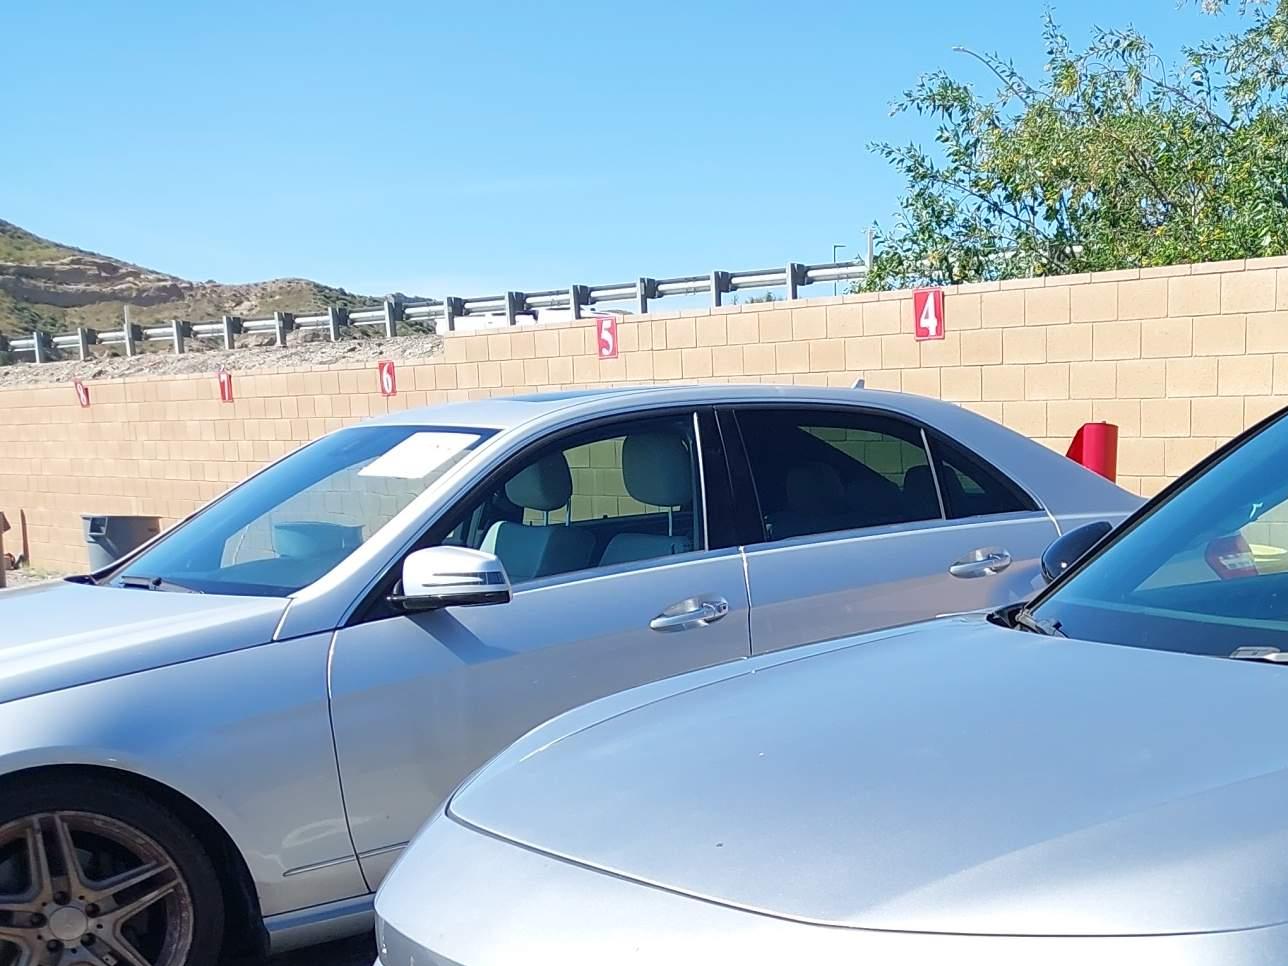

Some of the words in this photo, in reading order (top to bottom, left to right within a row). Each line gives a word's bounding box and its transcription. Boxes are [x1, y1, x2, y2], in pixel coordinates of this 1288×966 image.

[919, 290, 938, 337] 4
[600, 319, 614, 356] 5
[382, 362, 393, 394] 6
